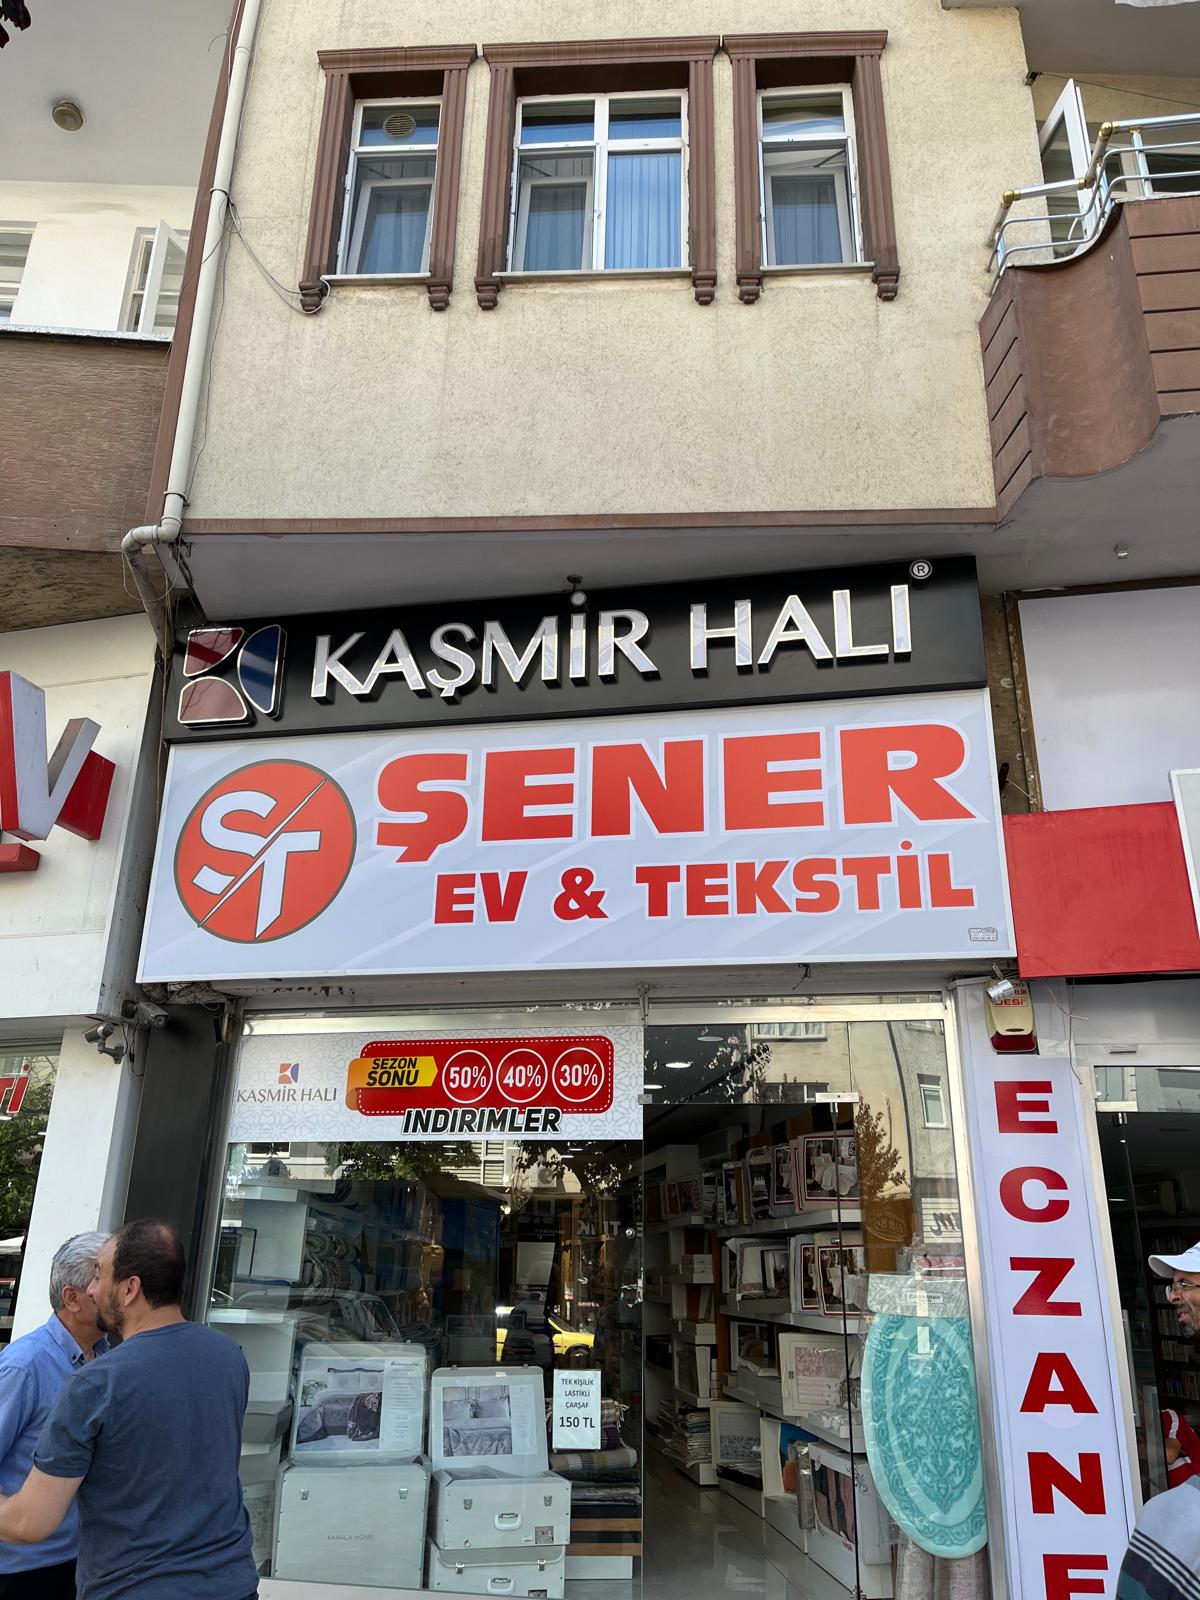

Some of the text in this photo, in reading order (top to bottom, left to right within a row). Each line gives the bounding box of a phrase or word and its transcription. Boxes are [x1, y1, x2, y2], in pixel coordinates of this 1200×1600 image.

[311, 590, 659, 700] KAŞMİR
[690, 584, 912, 672] HALI
[376, 723, 976, 863] ŞENER
[435, 840, 976, 924] EV & TEKSTİL
[371, 1057, 418, 1072] SEZON
[366, 1070, 420, 1087] SONU
[449, 1062, 599, 1089] 50% 40% 30%
[237, 1085, 337, 1104] KAŞMİR HALI
[574, 1378, 594, 1387] KİŞİLİK
[559, 1417, 595, 1428] 150 TL
